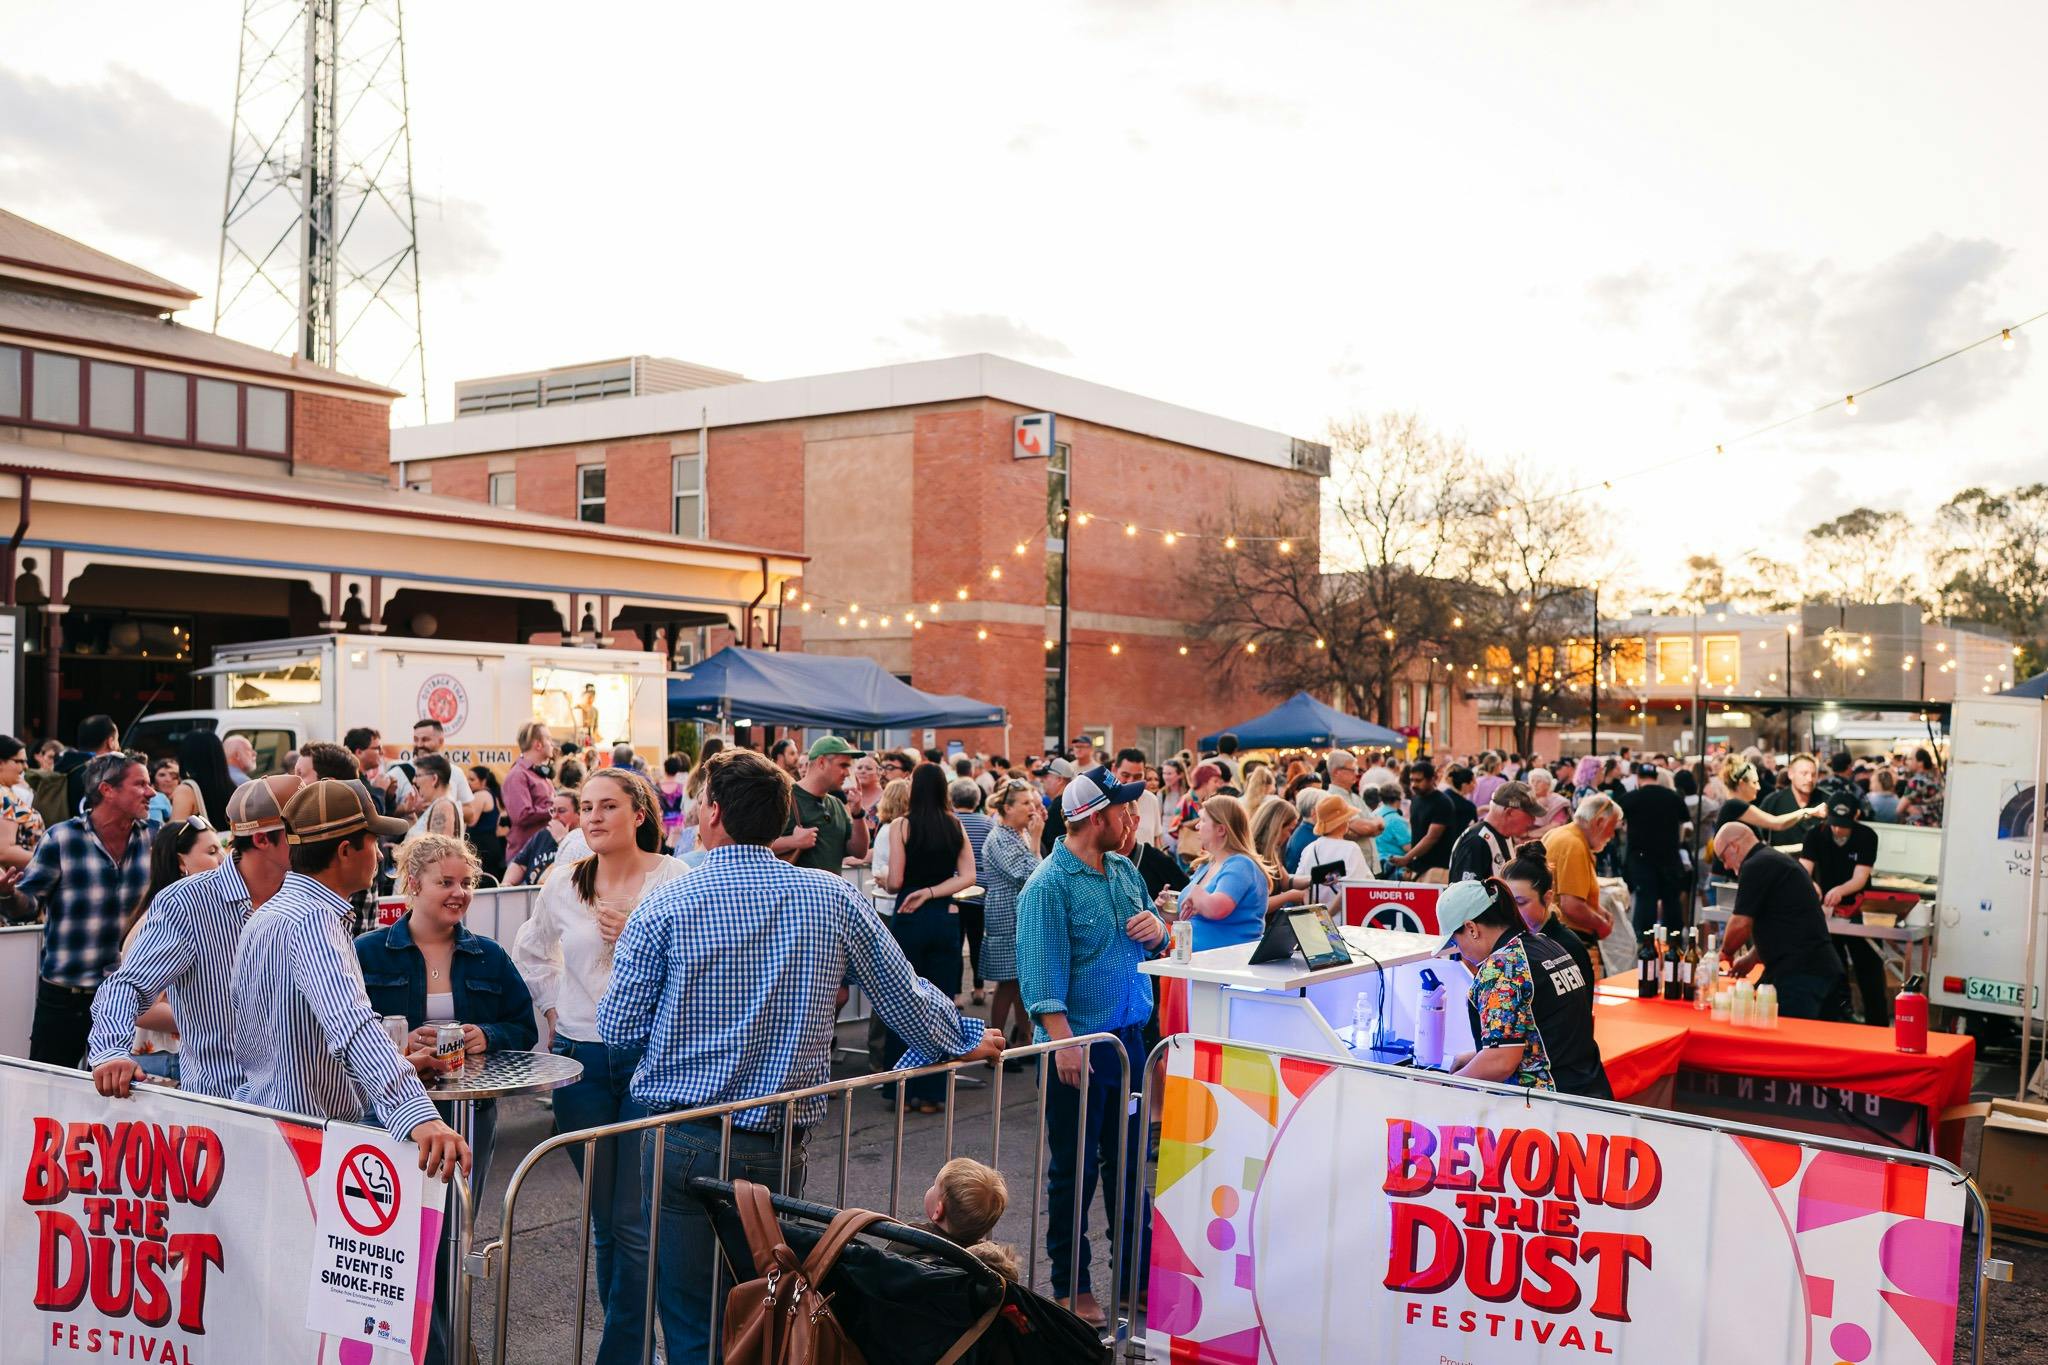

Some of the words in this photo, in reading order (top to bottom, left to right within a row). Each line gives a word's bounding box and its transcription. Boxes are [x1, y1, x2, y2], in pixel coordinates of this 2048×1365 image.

[401, 750, 471, 763] OACK
[478, 751, 512, 763] THAI
[391, 907, 402, 918] 18
[1369, 890, 1402, 900] UNDER
[1404, 891, 1415, 900] 18
[439, 1038, 465, 1055] HAHN
[23, 1117, 225, 1208] BEYOND
[1382, 1118, 1663, 1210] BEYOND
[83, 1197, 170, 1242] THE
[1455, 1193, 1581, 1238] THE
[328, 1234, 357, 1253] THIS
[359, 1241, 405, 1264] PUBLIC
[336, 1255, 378, 1276] EVENT
[381, 1265, 394, 1280] IS
[1383, 1202, 1653, 1323] DUST
[34, 1210, 224, 1335] DUST
[321, 1269, 405, 1301] SMOKE-FREE
[52, 1322, 194, 1365] FESTIVAL
[1406, 1302, 1613, 1354] FESTIVAL
